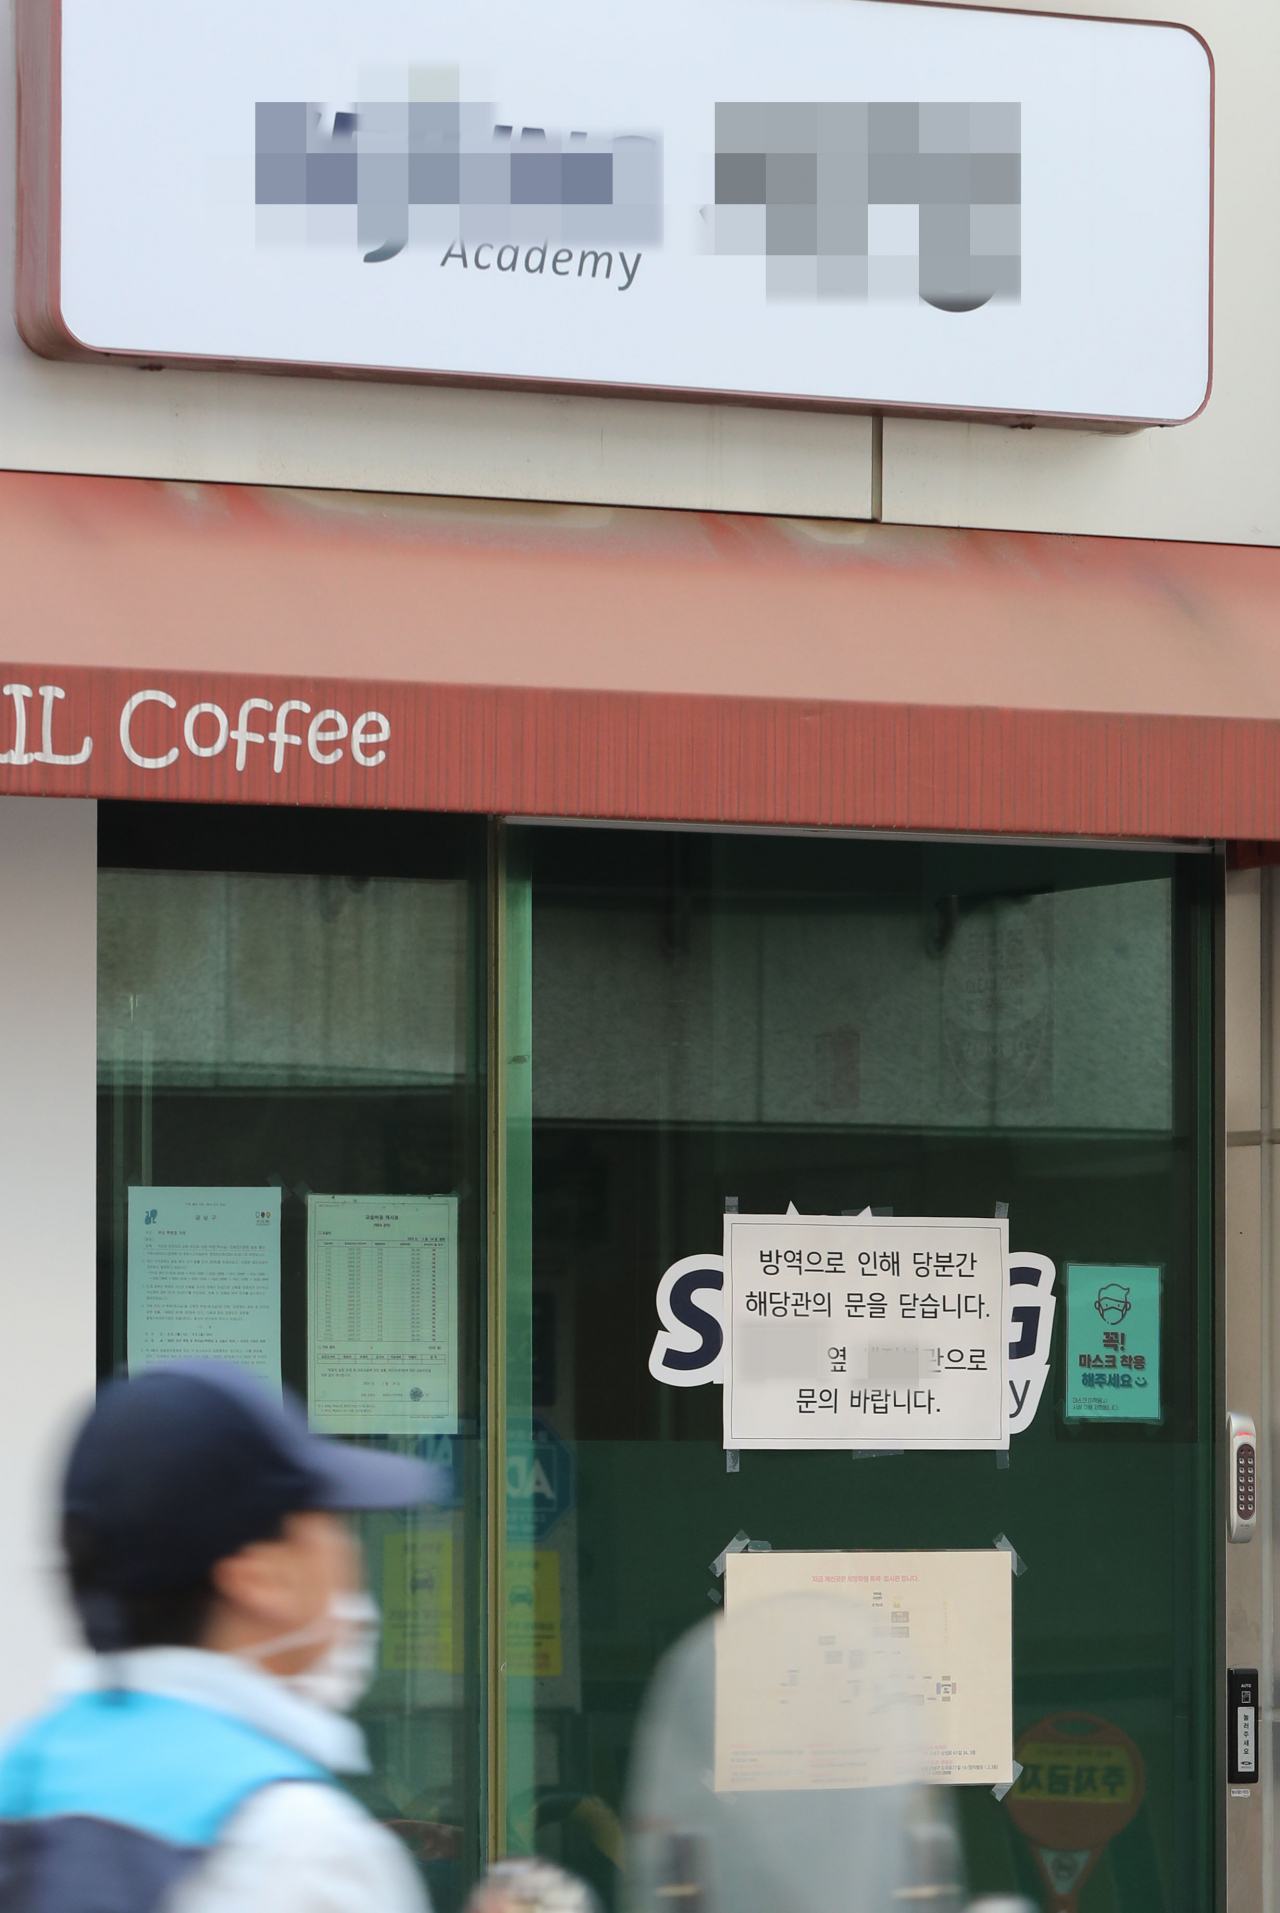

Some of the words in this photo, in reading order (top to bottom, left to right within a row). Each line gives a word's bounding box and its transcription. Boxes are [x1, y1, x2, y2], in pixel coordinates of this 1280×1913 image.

[440, 238, 643, 292] Academy
[0, 683, 94, 766] IL
[119, 689, 391, 773] Coffee
[759, 1249, 846, 1276] 방역으로
[858, 1251, 900, 1277] 인해
[913, 1252, 978, 1278] 당분간
[745, 1291, 832, 1318] 해당관의
[845, 1292, 888, 1319] 문을
[900, 1293, 991, 1320] 닫습니다.
[1102, 1332, 1125, 1351] 꼭!
[827, 1347, 847, 1373] 옆
[1078, 1354, 1117, 1369] 마스크
[1120, 1354, 1146, 1370] 착용
[1081, 1373, 1133, 1388] 해주세요
[796, 1388, 839, 1414] 문의
[850, 1388, 941, 1415] 바랍니다.
